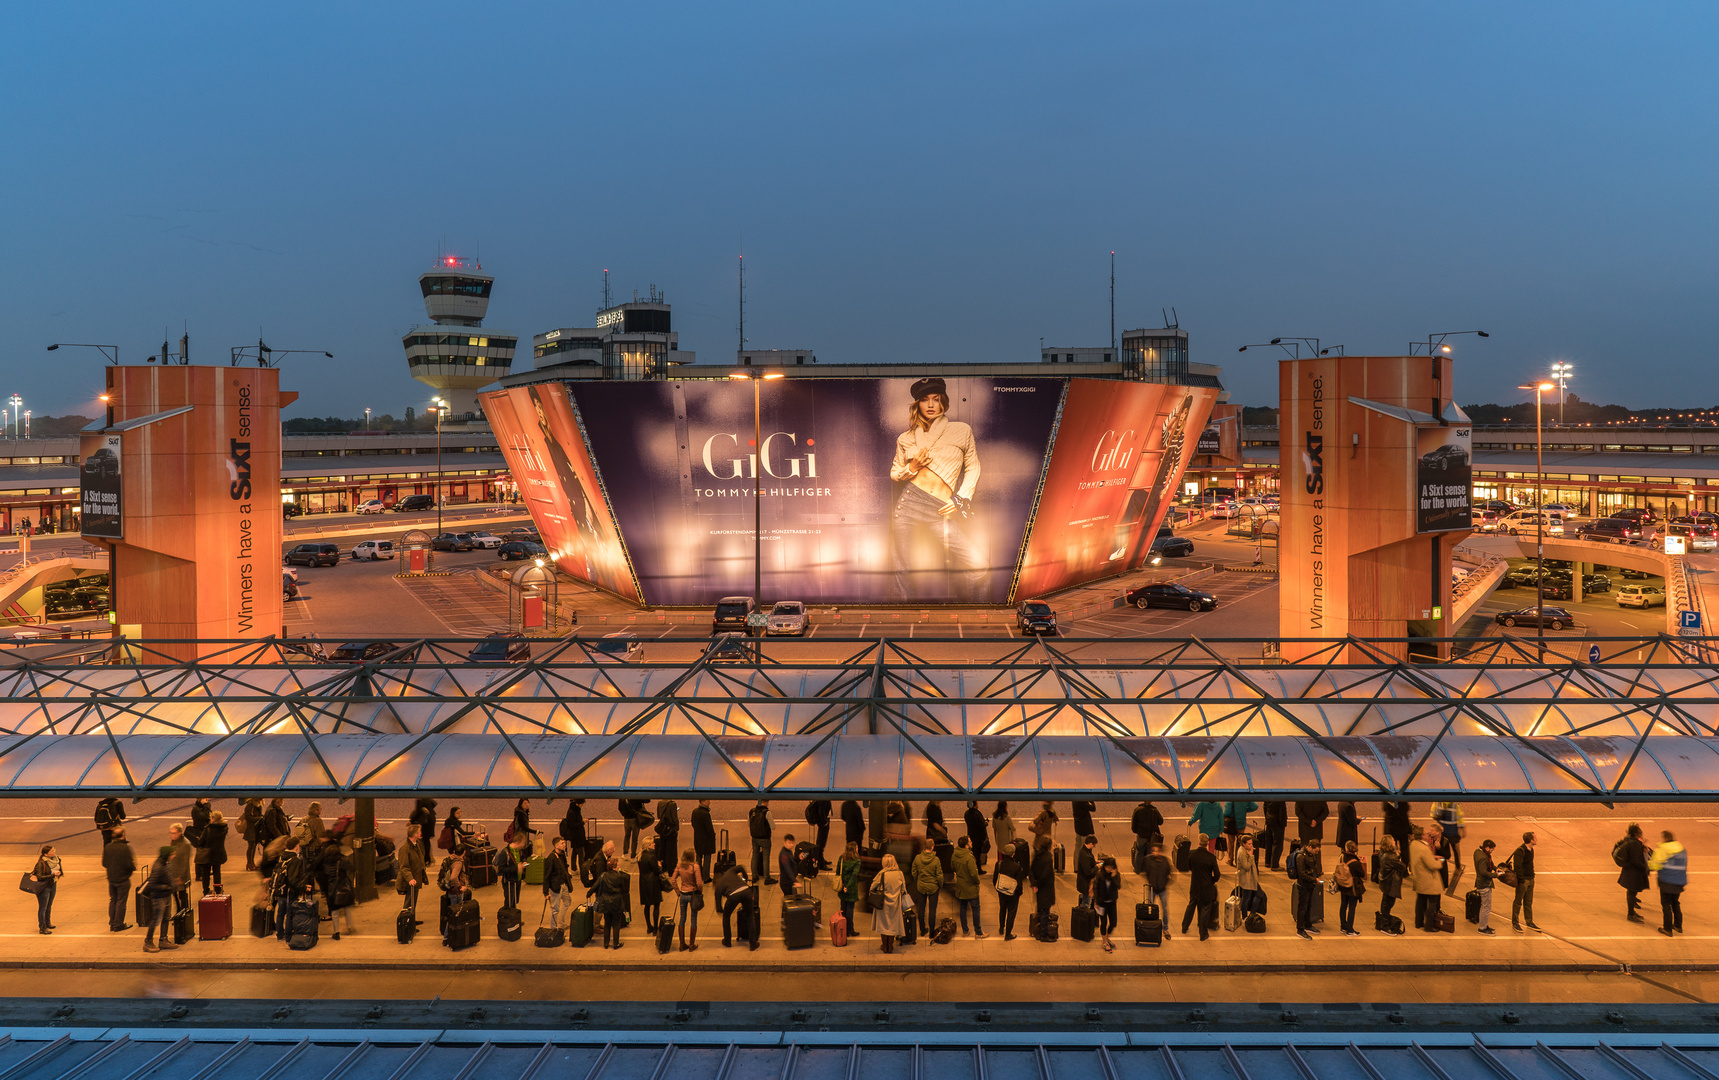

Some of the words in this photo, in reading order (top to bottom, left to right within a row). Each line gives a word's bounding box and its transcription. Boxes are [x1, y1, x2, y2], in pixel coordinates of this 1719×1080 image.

[702, 431, 820, 480] GiGi
[84, 490, 89, 502] A
[89, 490, 101, 502] Sixt
[101, 492, 118, 503] sense
[694, 488, 750, 498] TOMMY
[770, 487, 832, 497] HILFIGER
[1422, 485, 1428, 497] A
[1428, 484, 1444, 497] Sixt
[1444, 484, 1466, 496] sense
[83, 502, 92, 514] for
[92, 502, 102, 514] the
[102, 503, 120, 516] world.
[239, 503, 252, 514] a
[1313, 499, 1323, 510] a
[1420, 497, 1432, 510] for
[1432, 497, 1445, 509] the
[1445, 495, 1469, 508] world.
[237, 519, 252, 559] have
[1310, 514, 1323, 555] have
[237, 563, 253, 634] Winners
[1310, 560, 1323, 630] Winners
[1685, 612, 1696, 626] P
